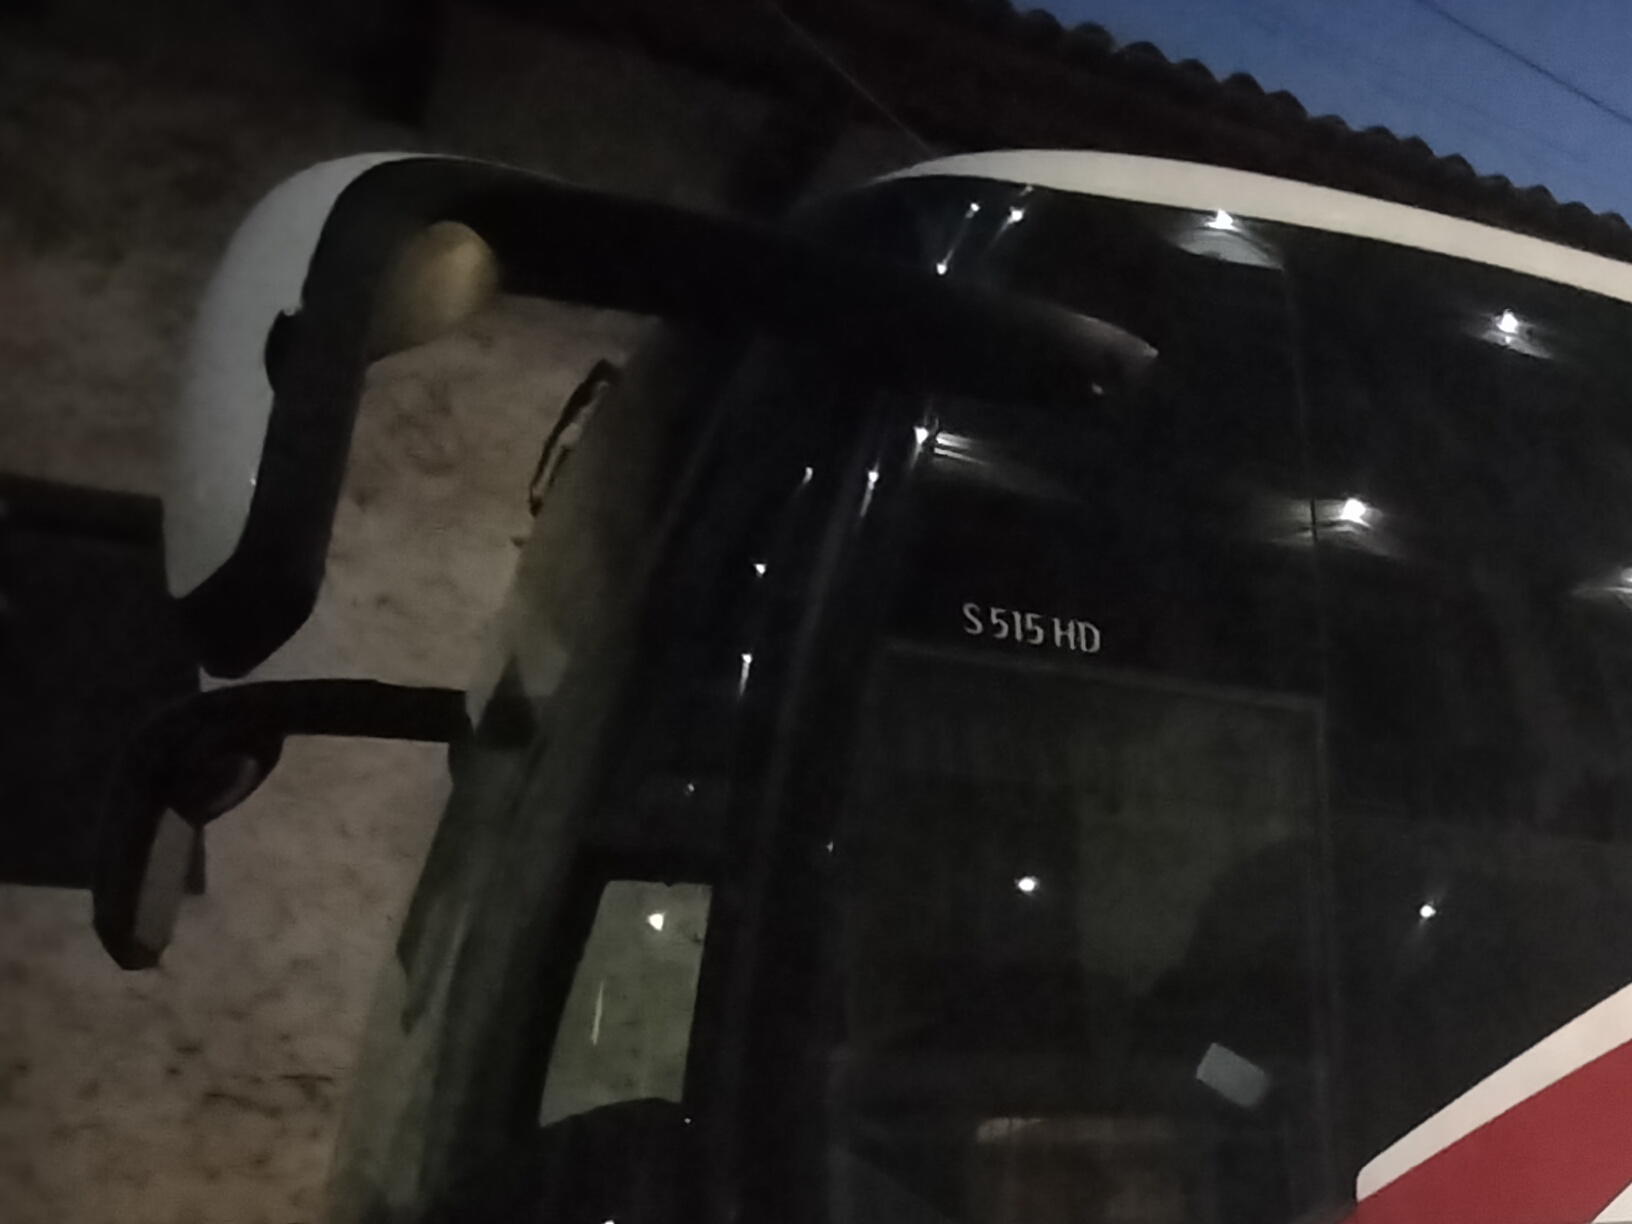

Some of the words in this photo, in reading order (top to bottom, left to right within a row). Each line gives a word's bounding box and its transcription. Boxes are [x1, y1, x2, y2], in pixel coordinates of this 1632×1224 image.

[962, 602, 984, 635] S
[990, 607, 1044, 645] 515
[1053, 616, 1101, 653] HD
